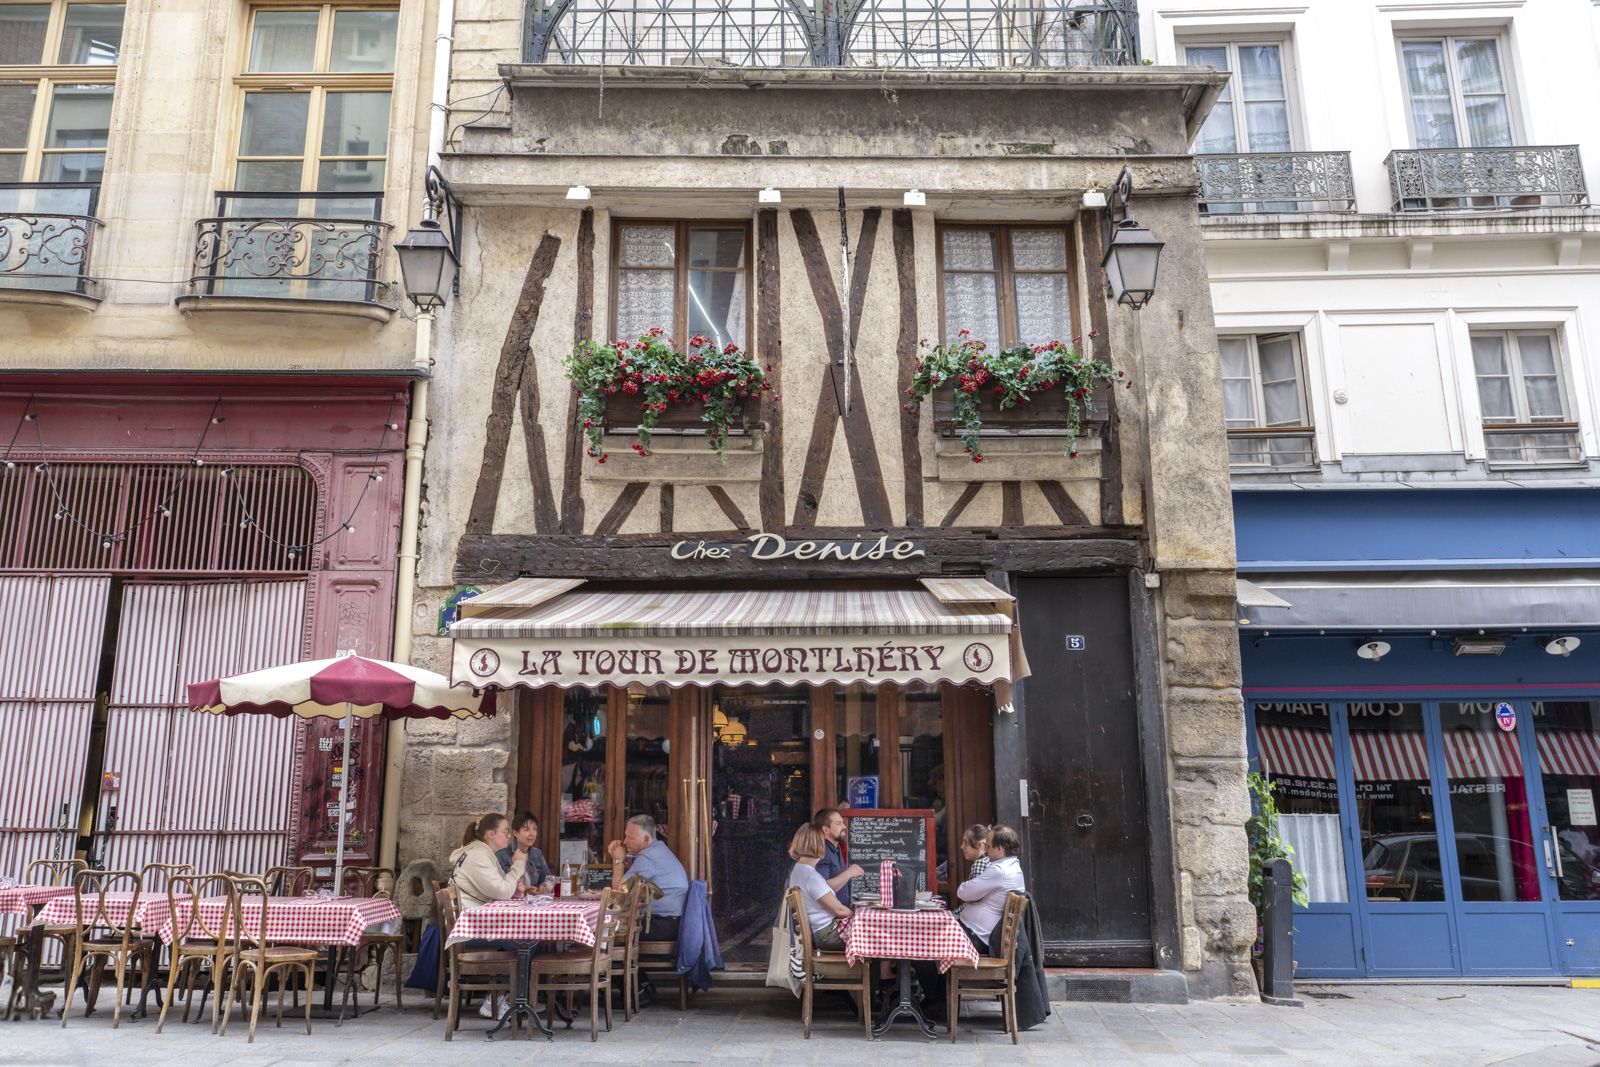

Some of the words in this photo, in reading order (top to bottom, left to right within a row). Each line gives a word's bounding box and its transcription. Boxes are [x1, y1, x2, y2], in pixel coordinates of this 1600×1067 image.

[670, 540, 731, 560] Chez
[747, 532, 925, 561] Denise
[1071, 638, 1079, 648] 5
[518, 650, 563, 676] LA
[573, 649, 665, 676] TOUR
[674, 649, 719, 675] DE
[728, 640, 945, 677] MONTLHÉRY
